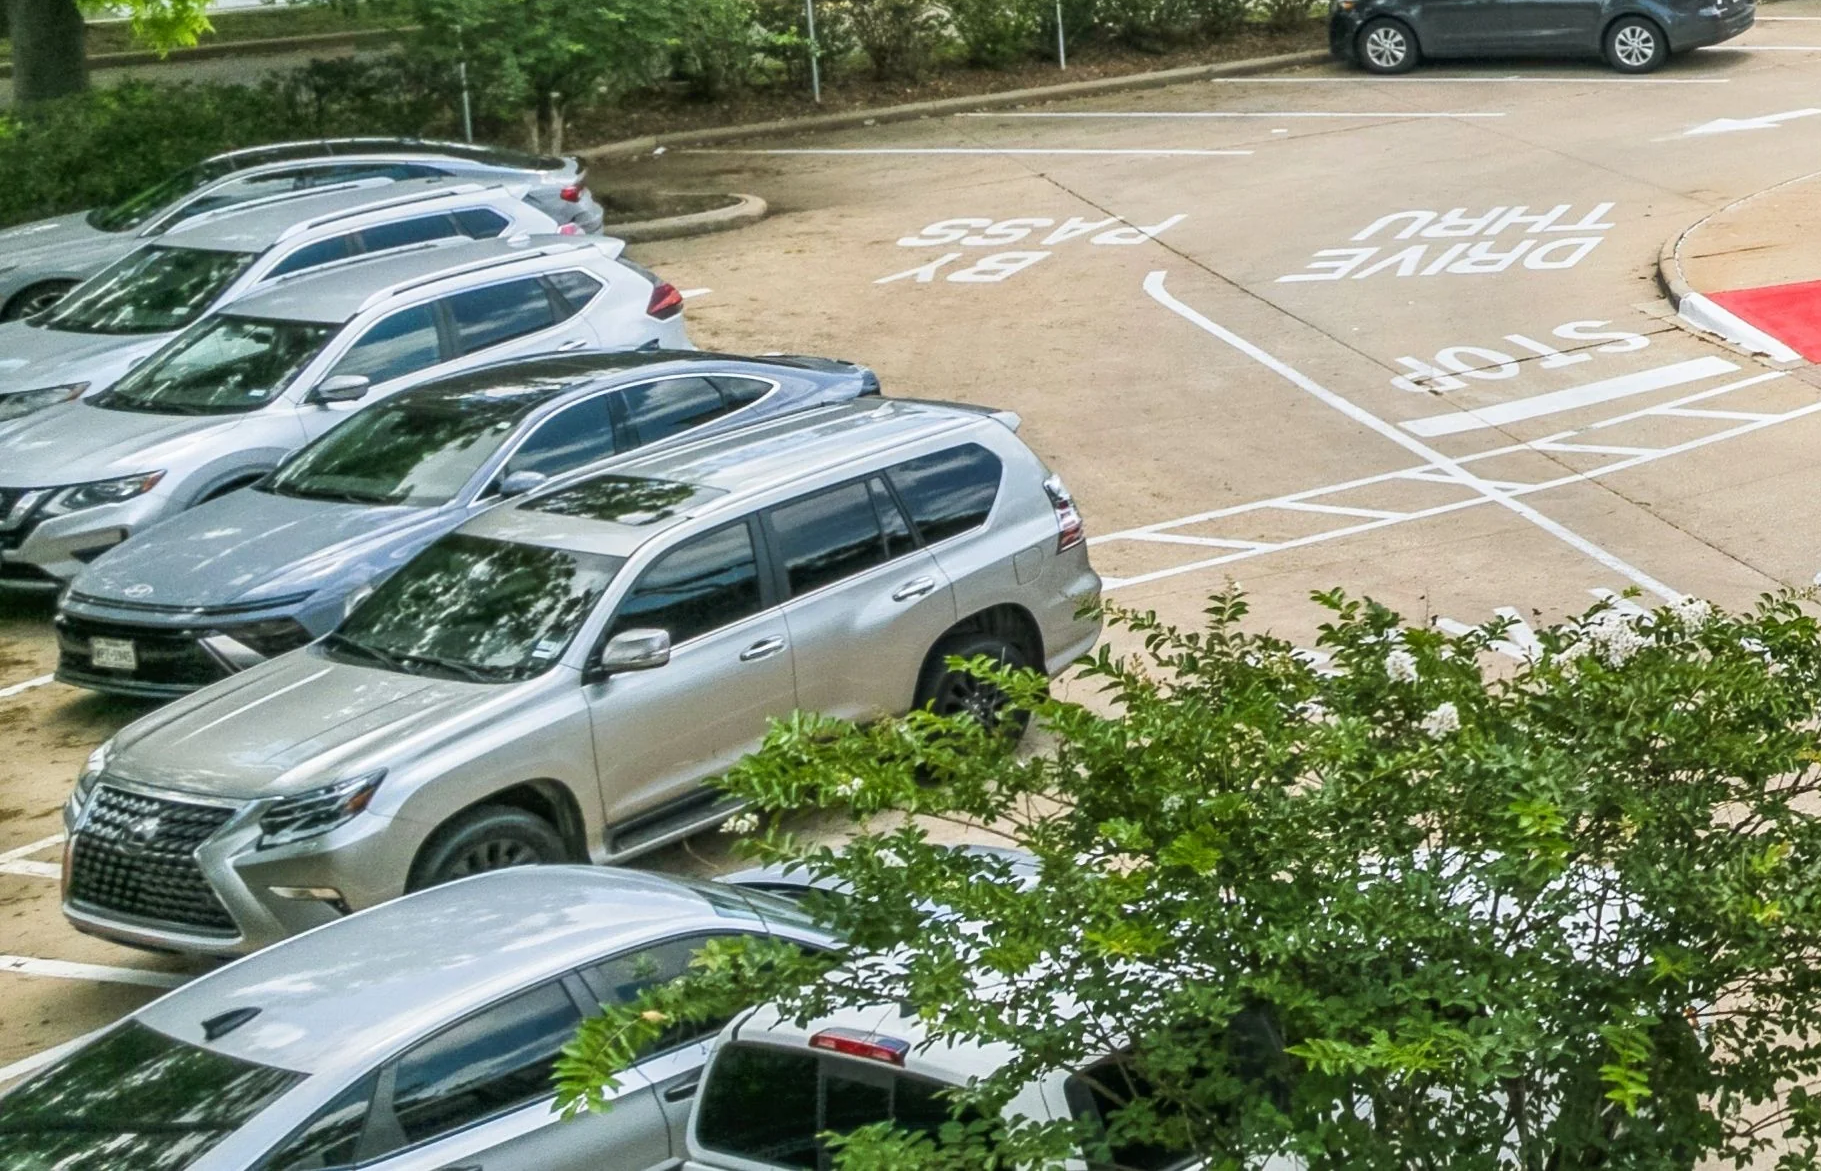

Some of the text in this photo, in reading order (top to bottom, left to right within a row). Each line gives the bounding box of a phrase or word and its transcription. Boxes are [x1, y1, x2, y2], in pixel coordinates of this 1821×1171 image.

[896, 213, 1189, 246] PASS
[1350, 201, 1616, 241] THRU
[874, 251, 1052, 282] BY
[1274, 236, 1604, 283] DRIVE
[1390, 320, 1650, 393] STOP
